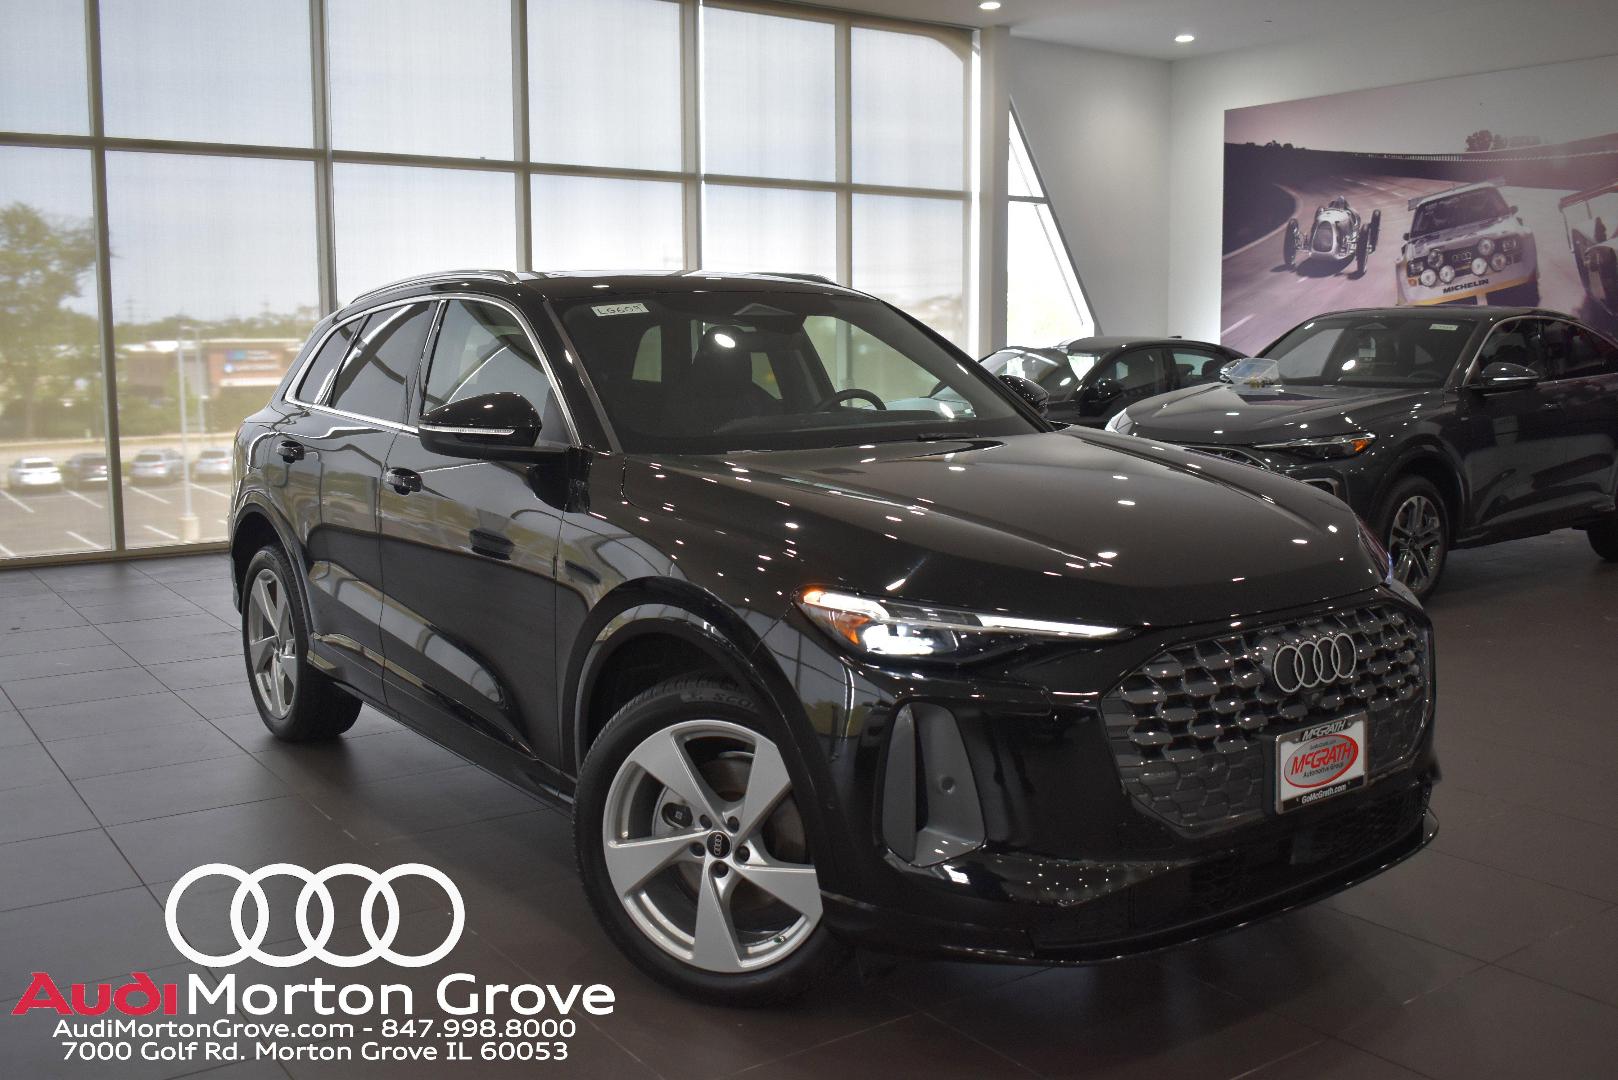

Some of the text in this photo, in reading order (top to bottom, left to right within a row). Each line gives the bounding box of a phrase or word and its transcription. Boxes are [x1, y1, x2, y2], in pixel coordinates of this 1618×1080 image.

[1443, 279, 1489, 294] MICHELIN
[1303, 761, 1344, 777] Automotive Group
[1301, 784, 1346, 804] GoMcGrath.com
